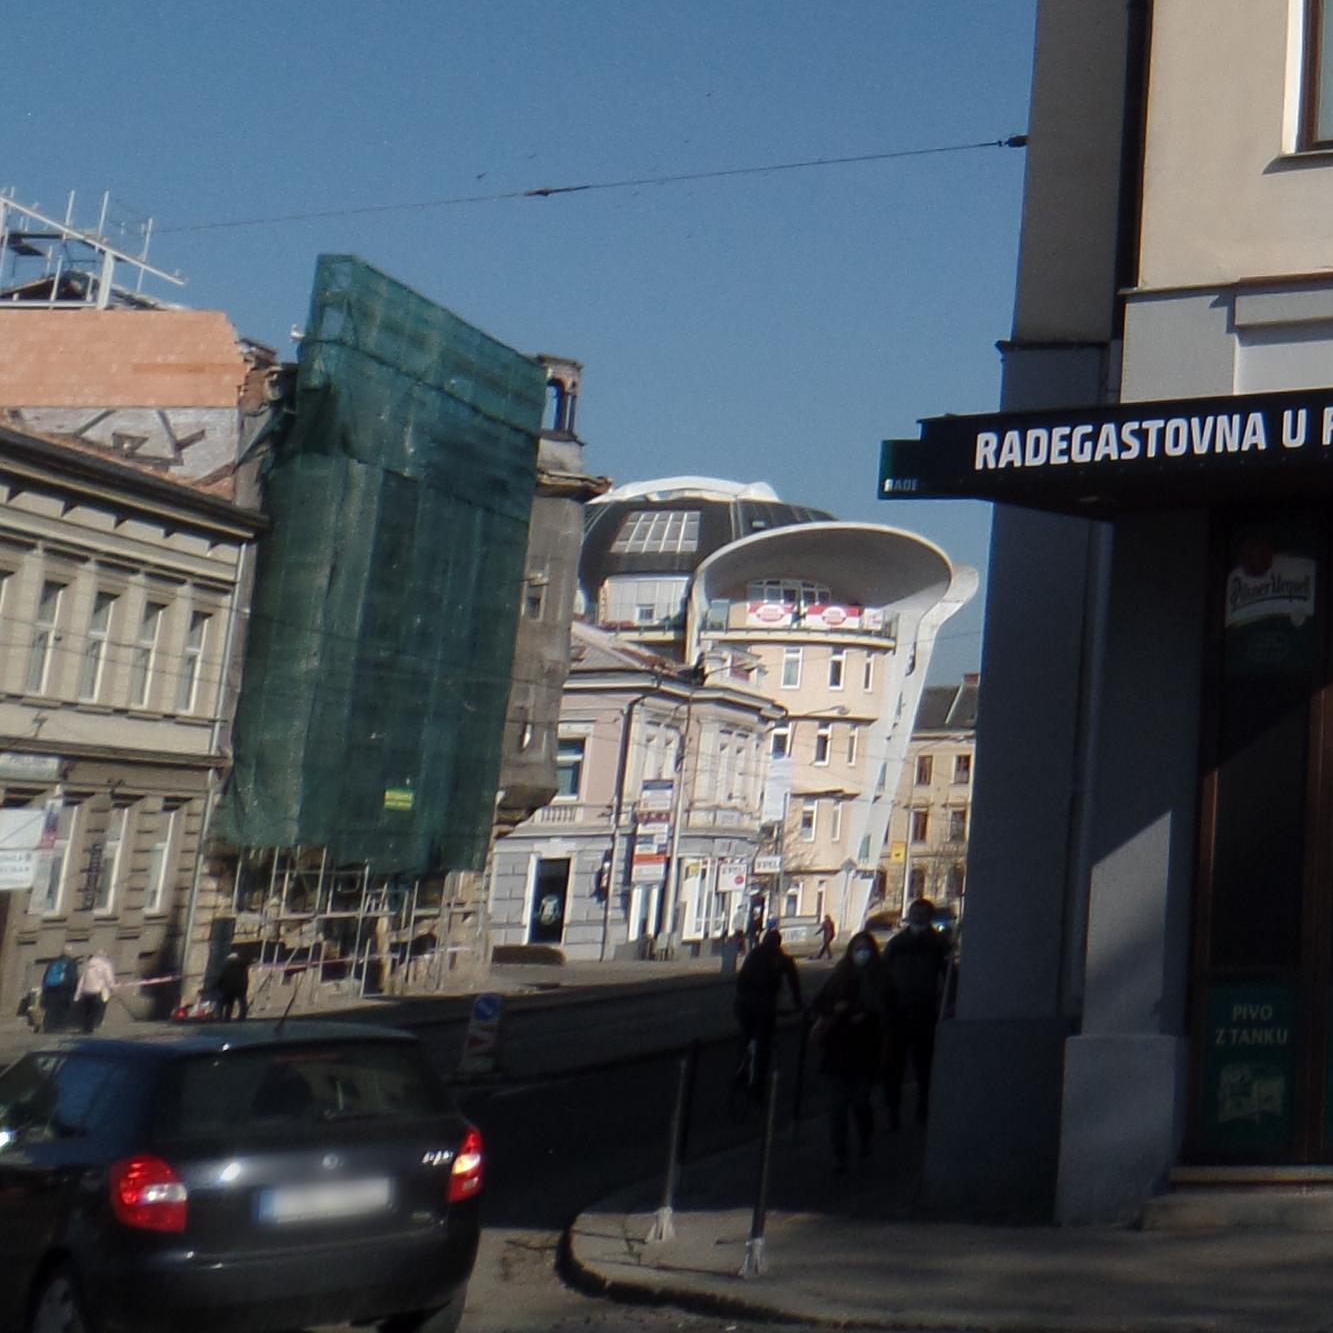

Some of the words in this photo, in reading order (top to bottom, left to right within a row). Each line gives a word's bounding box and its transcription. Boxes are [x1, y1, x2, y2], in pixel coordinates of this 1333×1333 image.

[975, 412, 1266, 471] RADEGASTOVNA
[1282, 408, 1307, 449] U
[883, 478, 921, 493] RADE
[1232, 1003, 1274, 1022] PIVO
[1215, 1028, 1226, 1045] Z
[1229, 1027, 1289, 1046] TANKU
